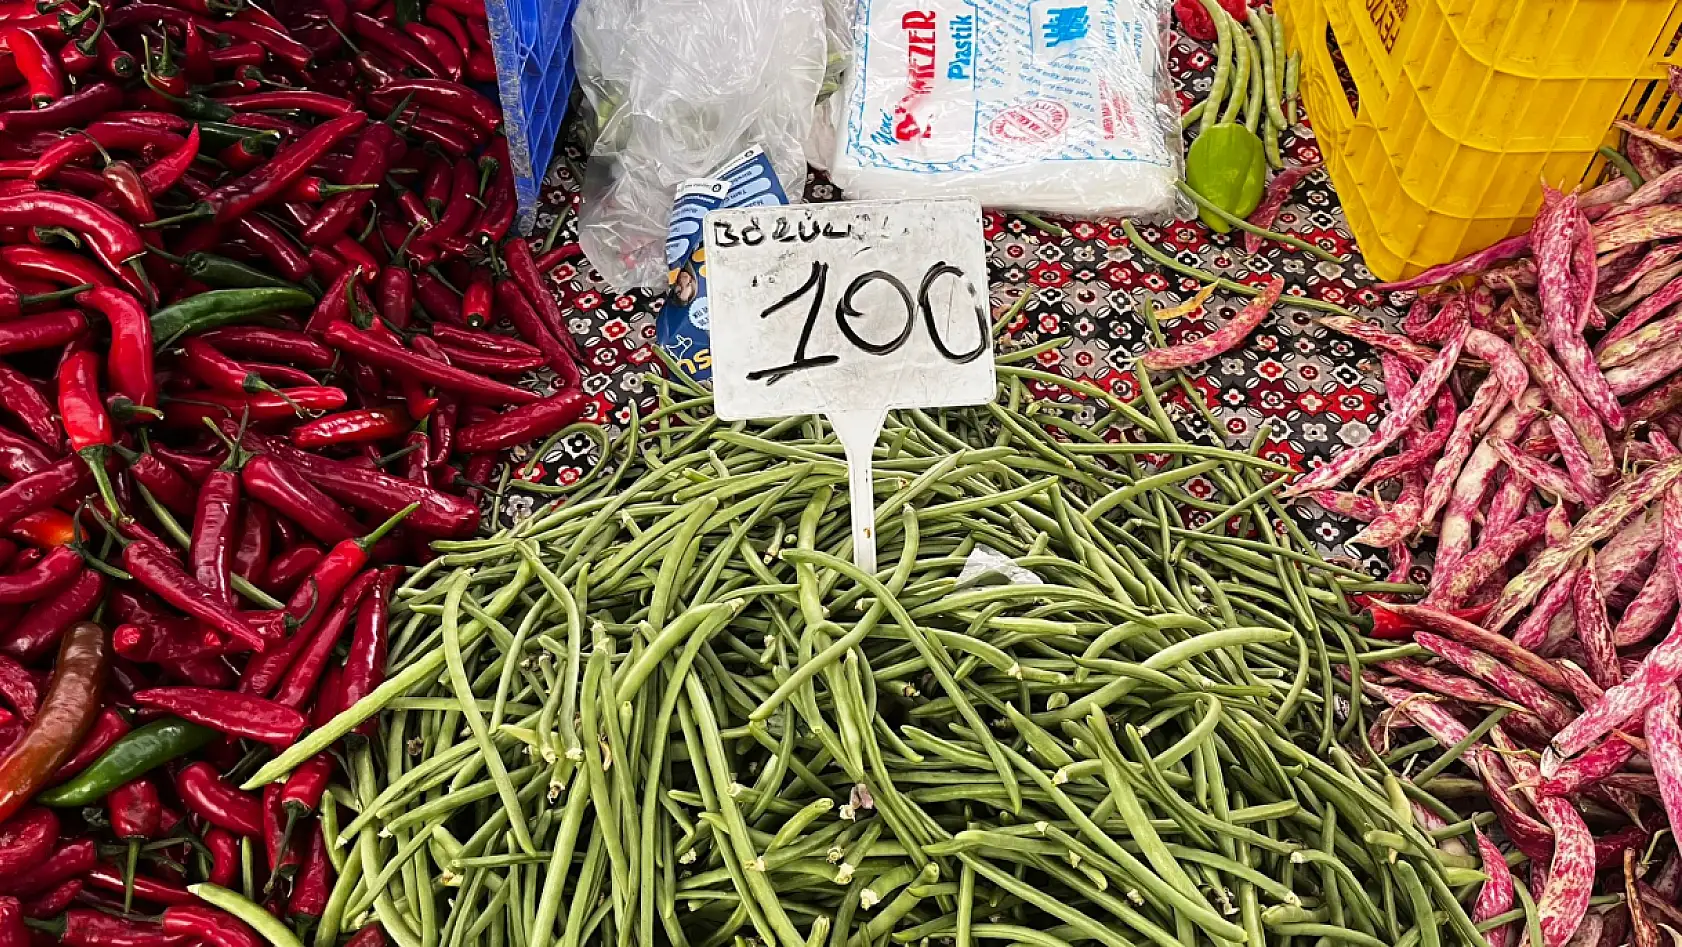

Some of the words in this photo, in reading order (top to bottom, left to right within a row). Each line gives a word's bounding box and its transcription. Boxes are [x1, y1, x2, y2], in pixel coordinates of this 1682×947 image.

[947, 14, 972, 80] Plastik
[870, 108, 899, 146] Yeni
[746, 261, 991, 386] 100
